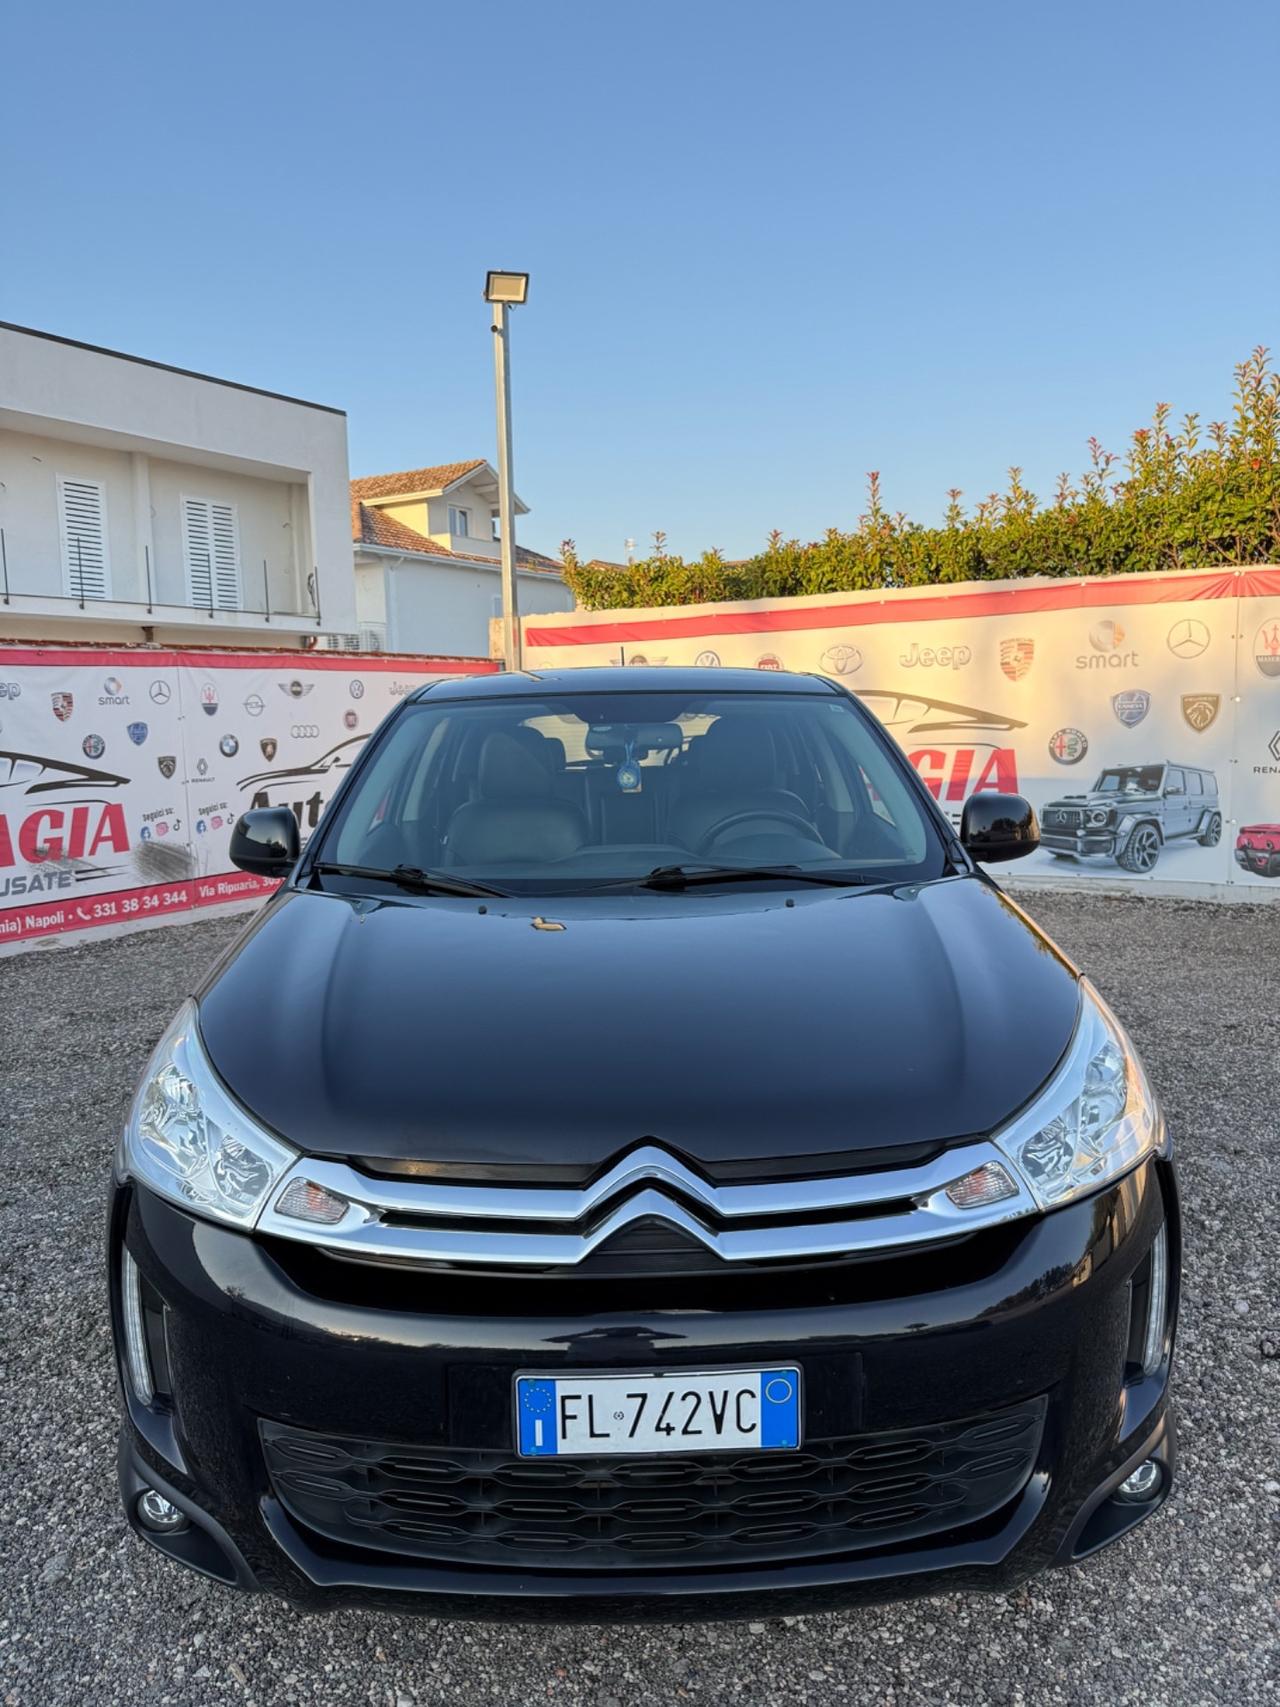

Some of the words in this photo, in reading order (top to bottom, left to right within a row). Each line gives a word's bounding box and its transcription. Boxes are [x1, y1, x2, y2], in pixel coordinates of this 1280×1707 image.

[898, 642, 972, 670] Jeep
[1076, 651, 1139, 670] smart
[98, 696, 130, 705] smart
[199, 886, 216, 898] Via
[25, 911, 65, 929] Napoli
[93, 902, 117, 918] 331
[121, 898, 140, 913] 38
[142, 894, 160, 909] 34
[163, 890, 188, 906] 344
